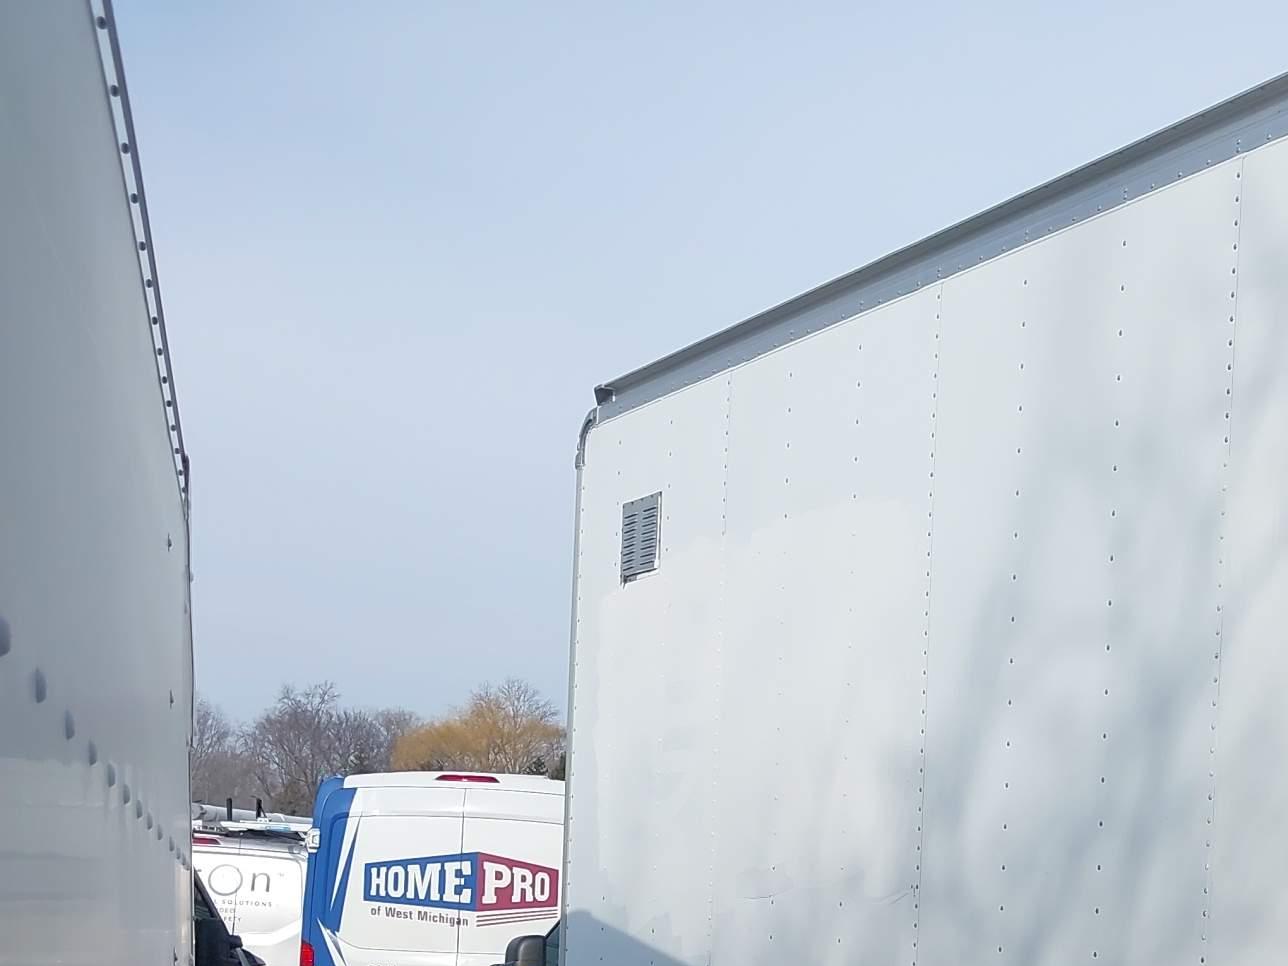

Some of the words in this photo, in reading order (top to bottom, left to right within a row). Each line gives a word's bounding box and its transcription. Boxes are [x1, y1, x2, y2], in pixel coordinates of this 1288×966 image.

[370, 861, 472, 904] HOME
[482, 861, 551, 904] PRO
[370, 906, 381, 916] of
[385, 907, 413, 920] West
[417, 910, 469, 927] Michigan
